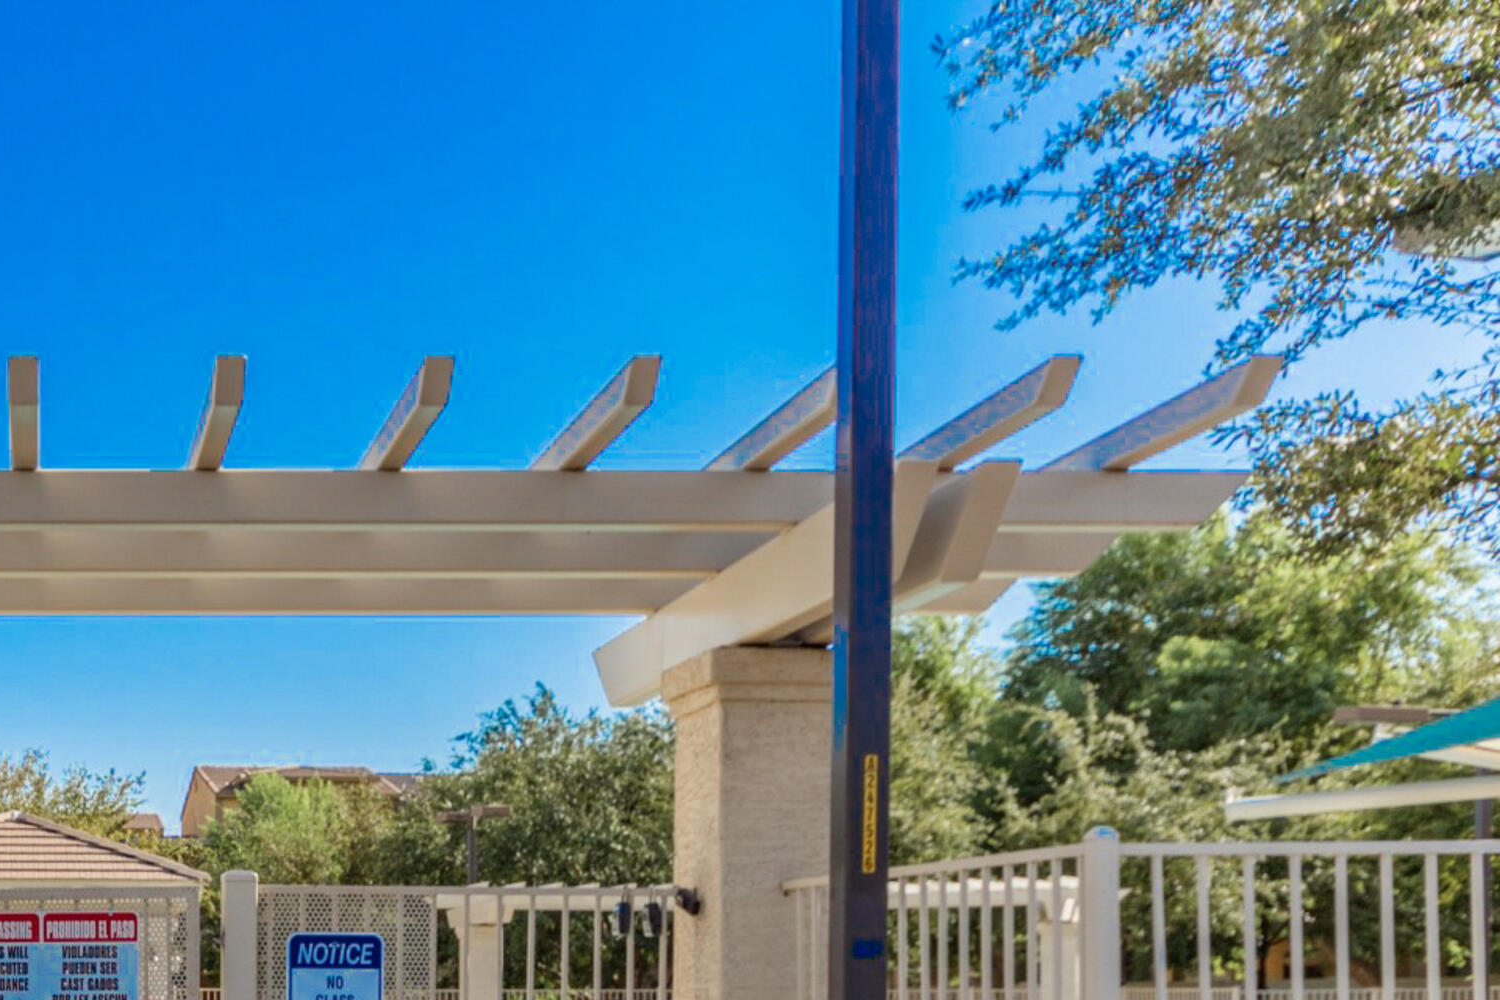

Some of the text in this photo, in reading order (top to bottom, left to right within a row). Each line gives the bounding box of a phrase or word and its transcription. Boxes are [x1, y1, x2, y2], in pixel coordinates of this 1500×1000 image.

[46, 920, 135, 940] PROHIBIDO EL PASO
[8, 946, 28, 959] WILL
[62, 946, 118, 959] VIOLADORES
[297, 943, 374, 965] NOTICE
[63, 962, 117, 975] PUEDEN SER
[327, 976, 344, 989] NO
